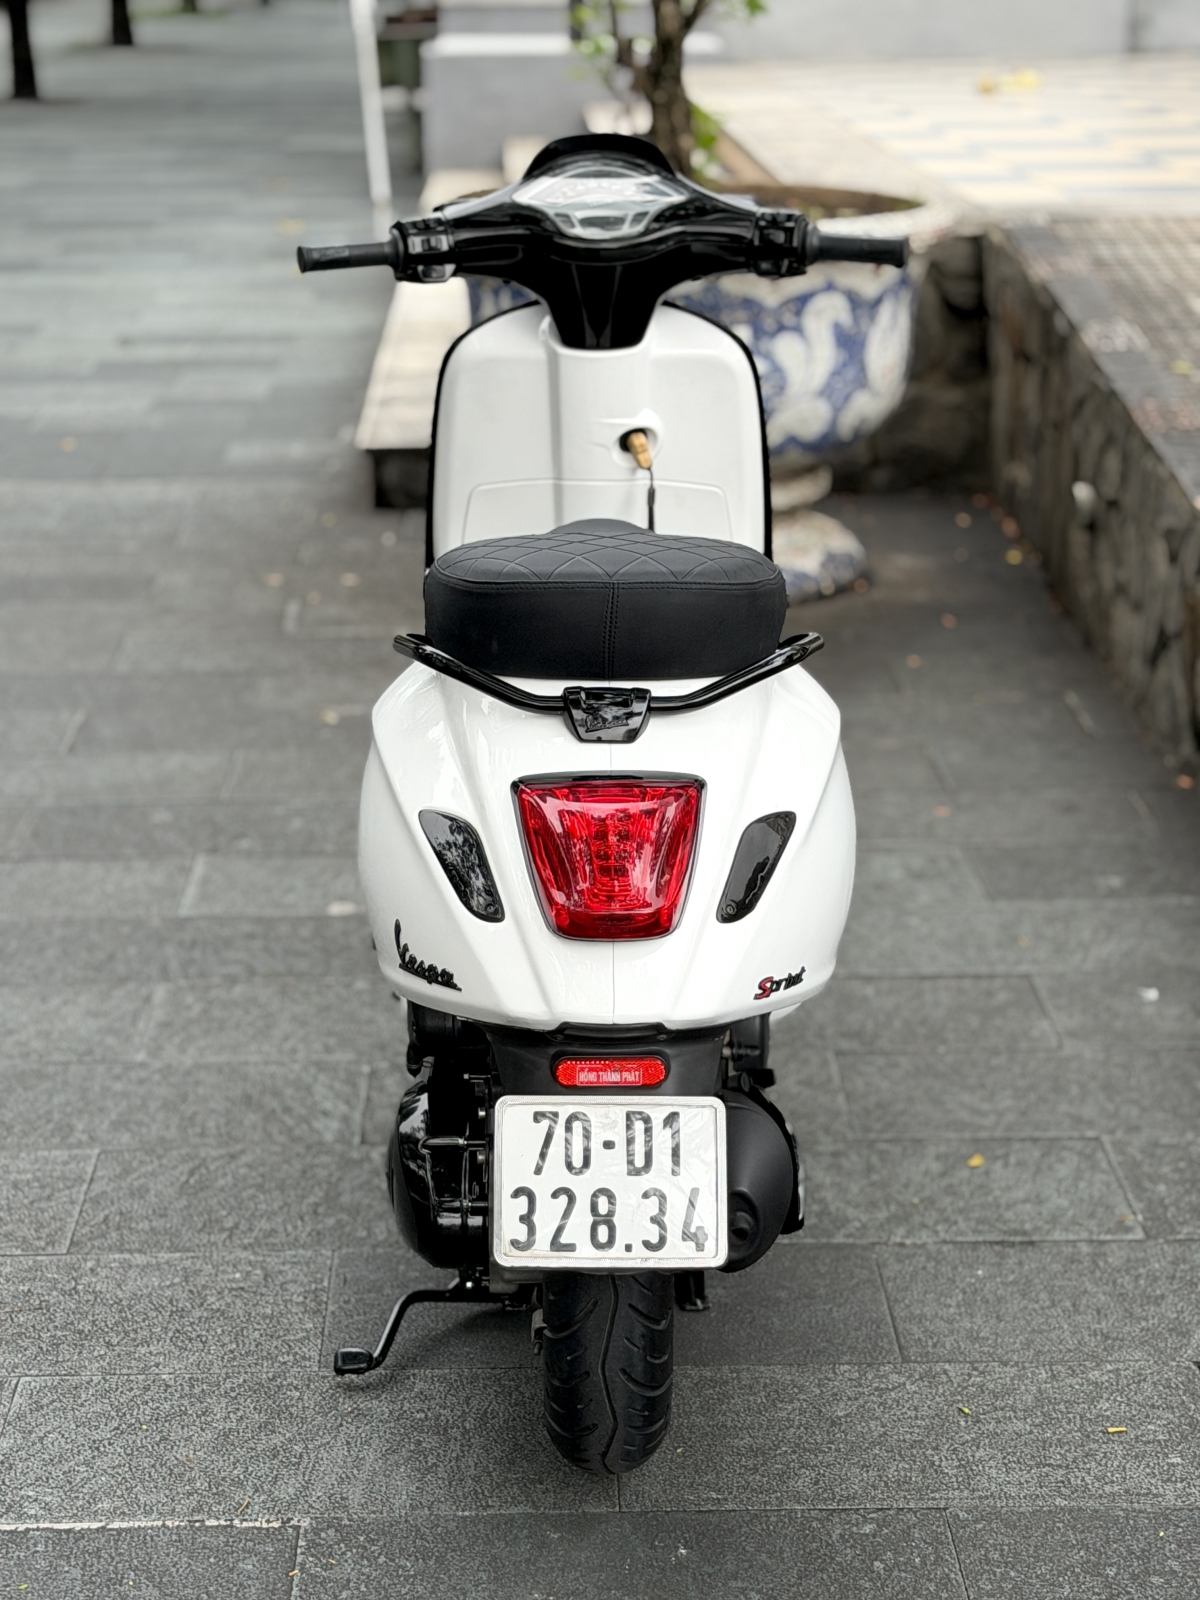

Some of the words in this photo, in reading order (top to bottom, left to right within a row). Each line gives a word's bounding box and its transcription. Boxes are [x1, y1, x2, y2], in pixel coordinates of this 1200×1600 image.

[394, 918, 462, 992] Vespa
[753, 966, 806, 1000] Sprint
[533, 1111, 681, 1176] 70-D1
[510, 1186, 708, 1252] 328.34
